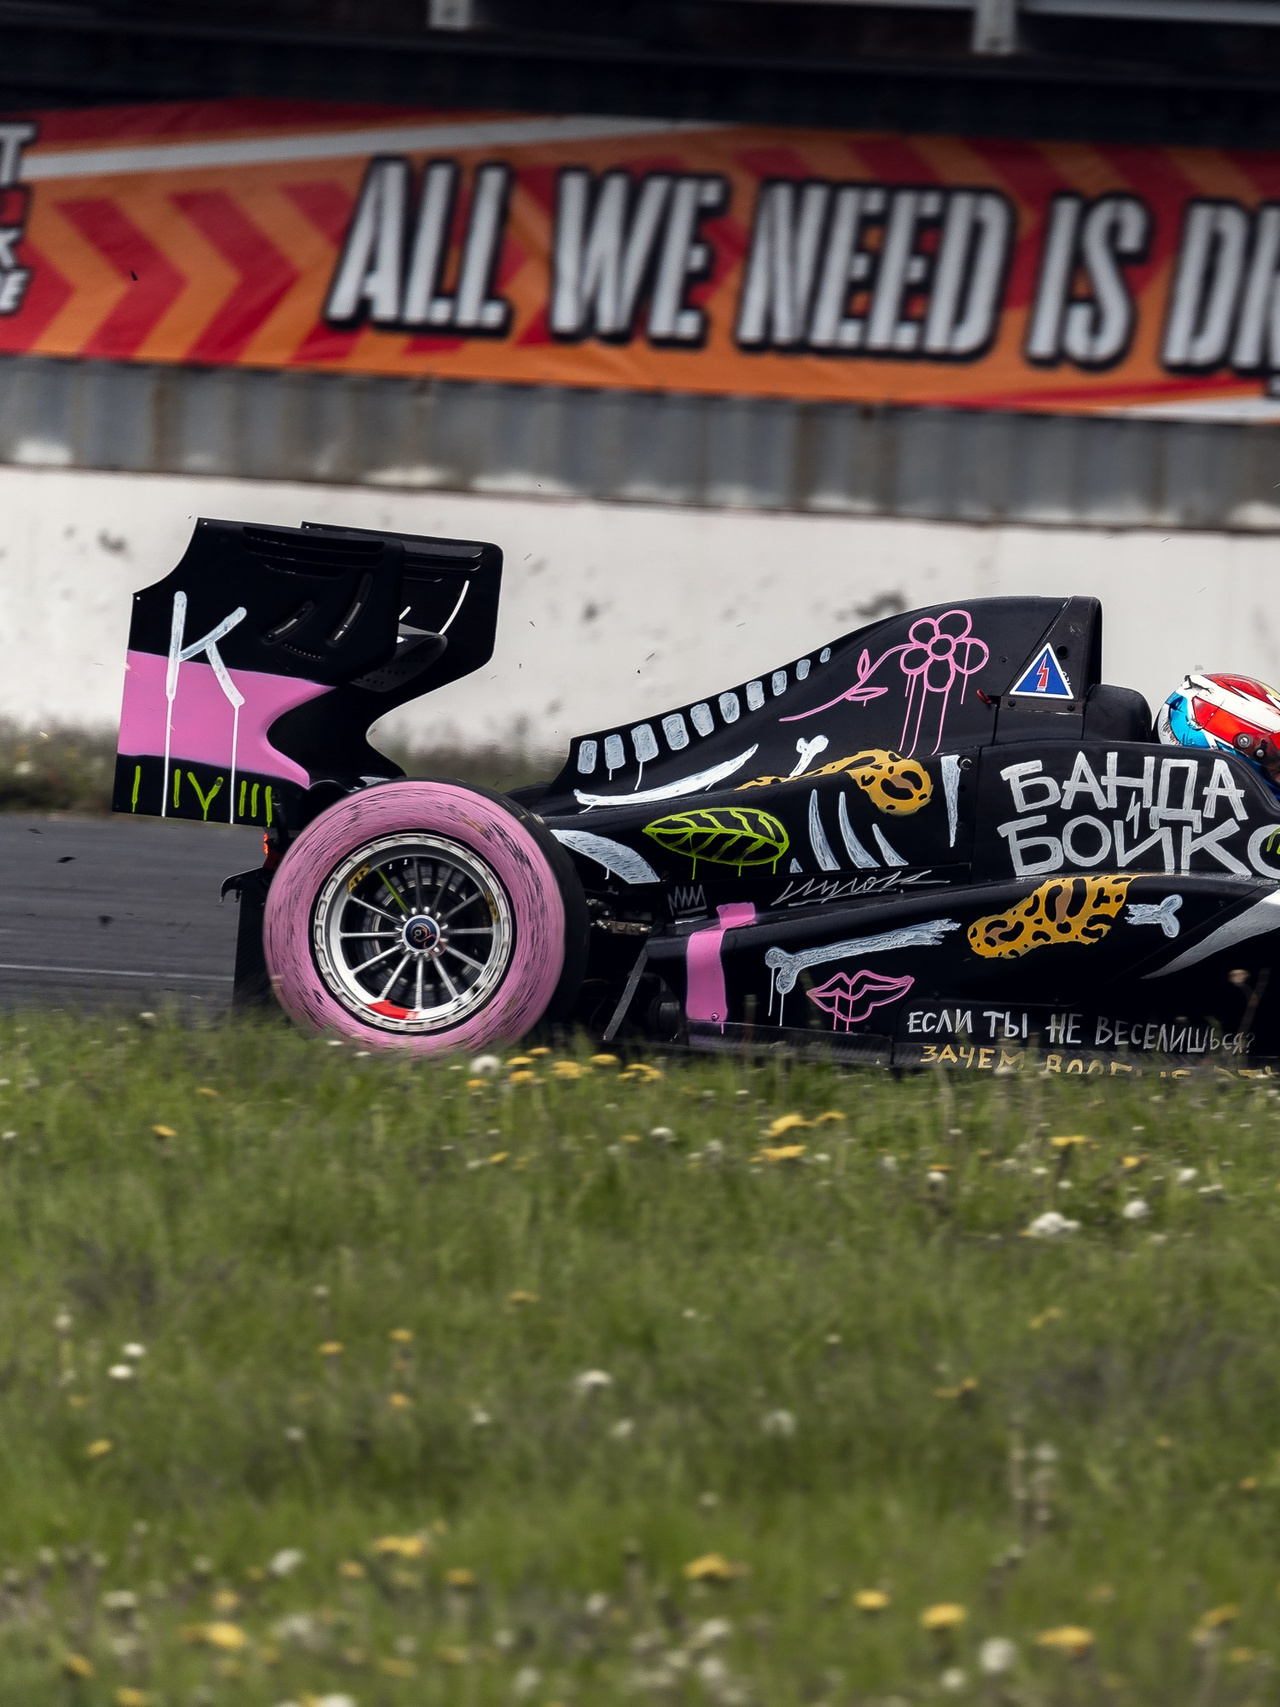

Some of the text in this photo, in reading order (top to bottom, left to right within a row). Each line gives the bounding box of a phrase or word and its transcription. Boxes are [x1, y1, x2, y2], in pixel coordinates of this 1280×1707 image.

[327, 159, 508, 326] ALL
[550, 169, 727, 340] WE
[737, 180, 1012, 353] NEED
[1027, 195, 1150, 365] IS
[1000, 750, 1250, 833] БАНДА
[907, 1008, 973, 1033] ЕСЛИ
[983, 1011, 1028, 1039] ТЫ
[1045, 1013, 1084, 1045] НЕ
[920, 1044, 1025, 1070] ЗАЧЕМ
